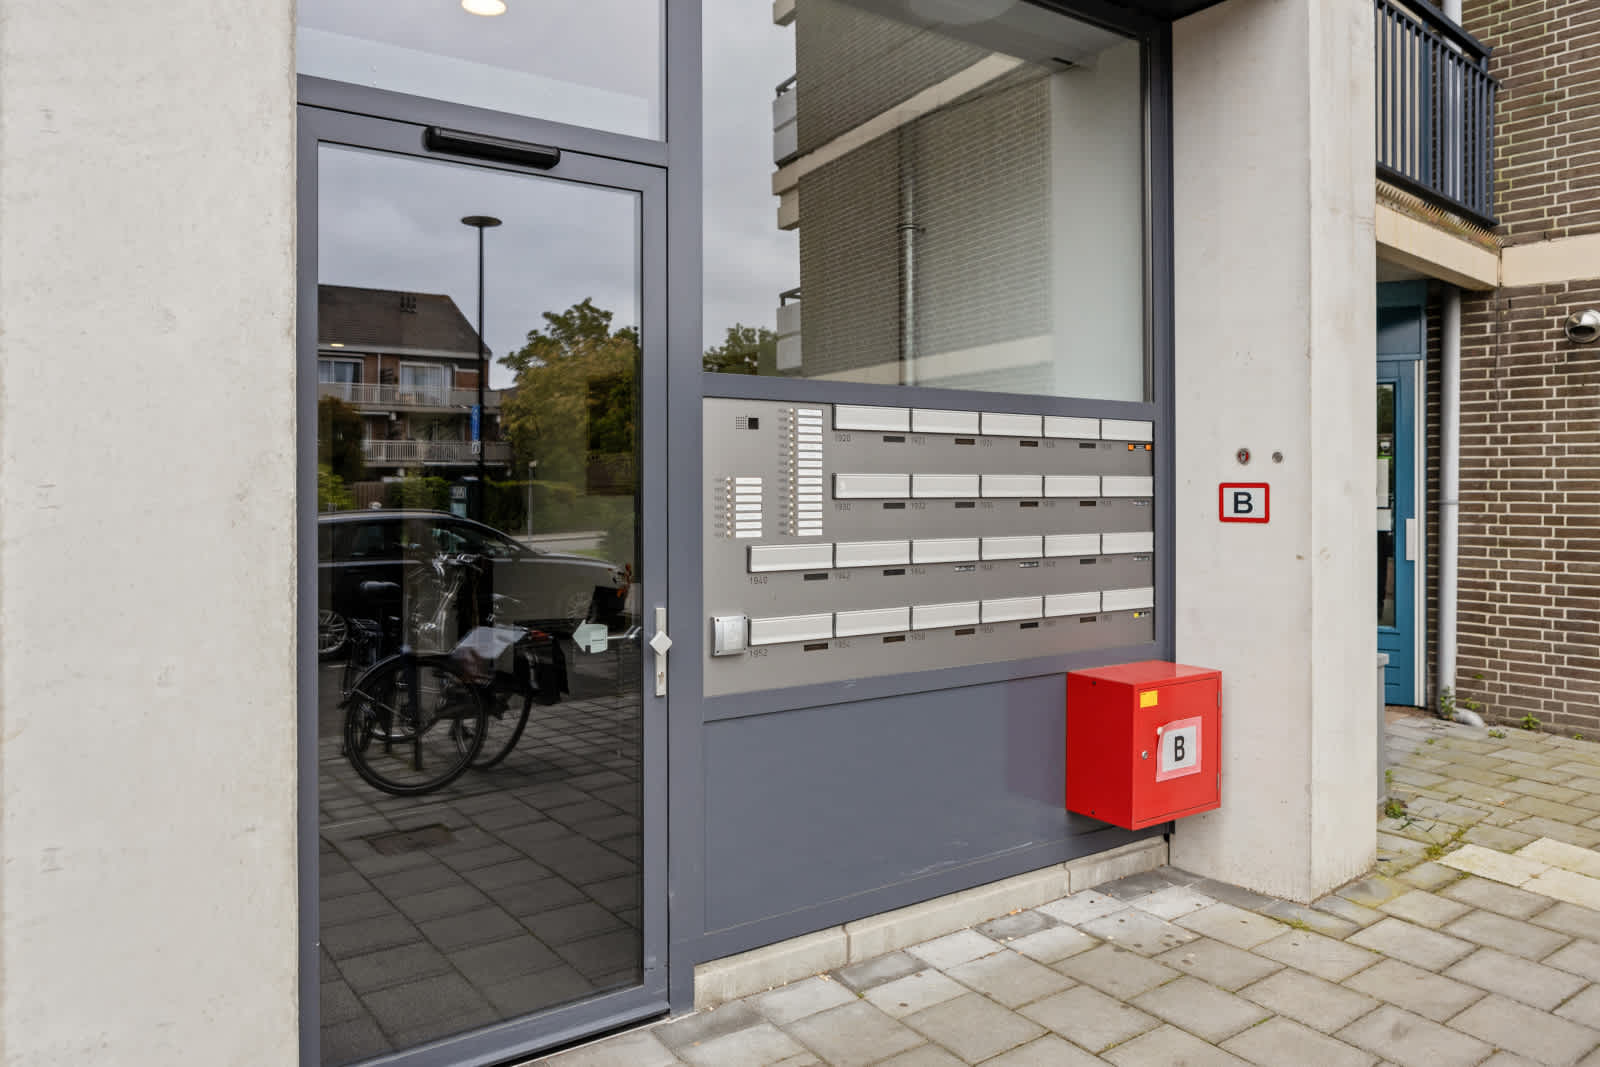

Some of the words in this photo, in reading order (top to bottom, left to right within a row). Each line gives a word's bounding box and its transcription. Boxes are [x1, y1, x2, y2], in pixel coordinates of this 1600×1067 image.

[1233, 491, 1253, 514] B
[750, 575, 769, 585] 1940
[750, 648, 768, 657] 1952
[1174, 735, 1185, 762] B
